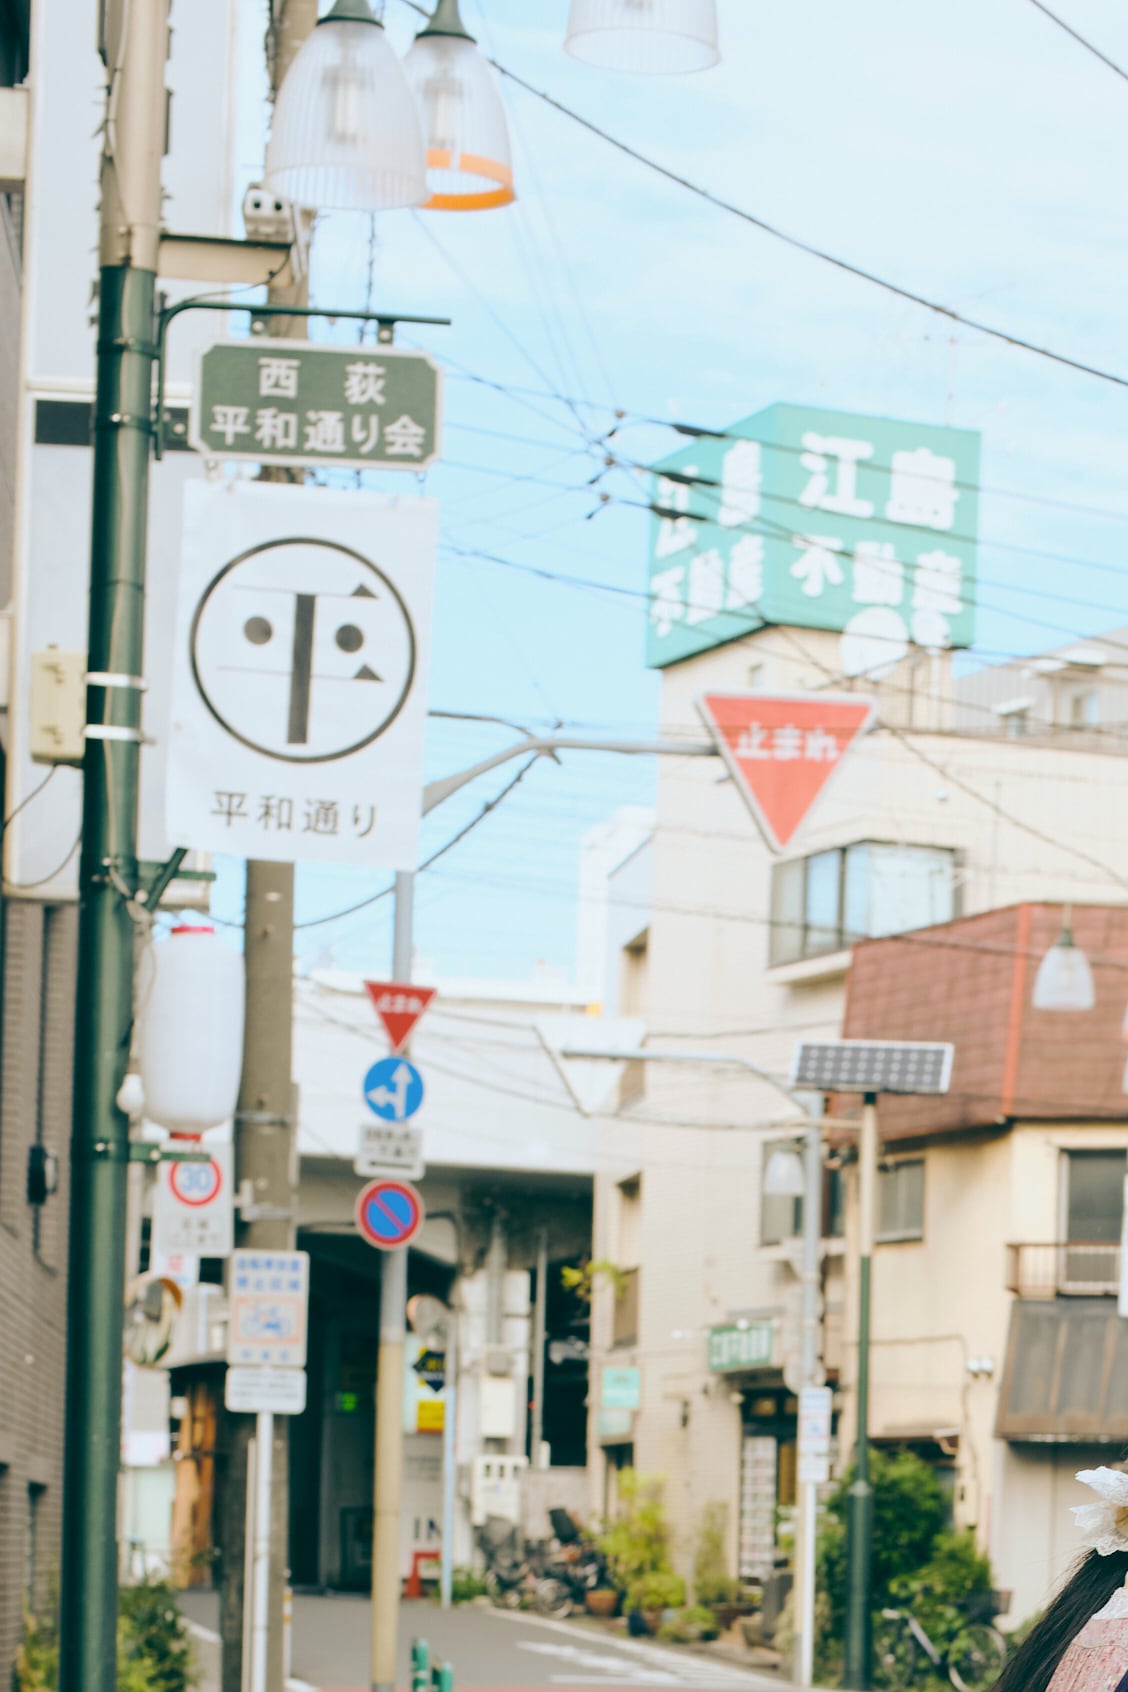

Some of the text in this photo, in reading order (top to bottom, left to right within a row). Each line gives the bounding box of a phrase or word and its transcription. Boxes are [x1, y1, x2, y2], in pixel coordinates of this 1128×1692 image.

[209, 405, 426, 457] 平和通り会
[735, 721, 839, 762] 止まれ
[210, 790, 376, 838] 平和通り
[180, 1163, 213, 1193] 30
